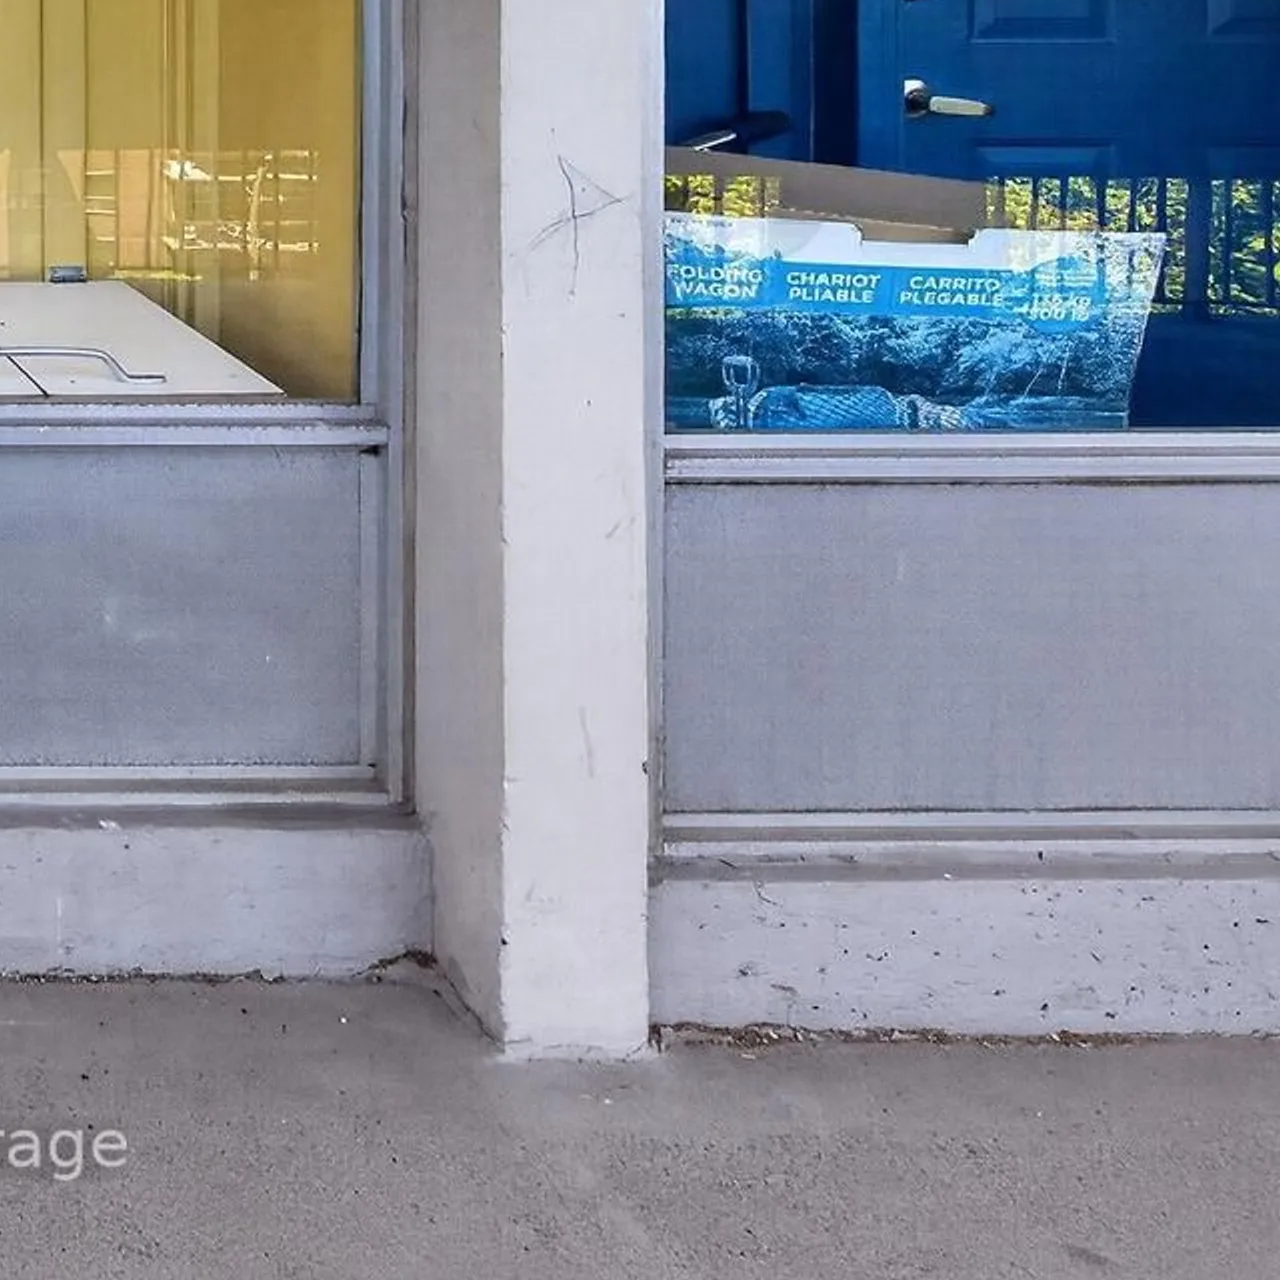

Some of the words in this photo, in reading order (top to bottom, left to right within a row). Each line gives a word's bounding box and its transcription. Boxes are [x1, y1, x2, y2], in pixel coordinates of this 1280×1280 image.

[786, 271, 882, 290] CHARIOT
[909, 275, 1002, 293] CARRITO
[789, 286, 876, 304] PLIABLE
[899, 290, 1006, 307] PLEGABLE
